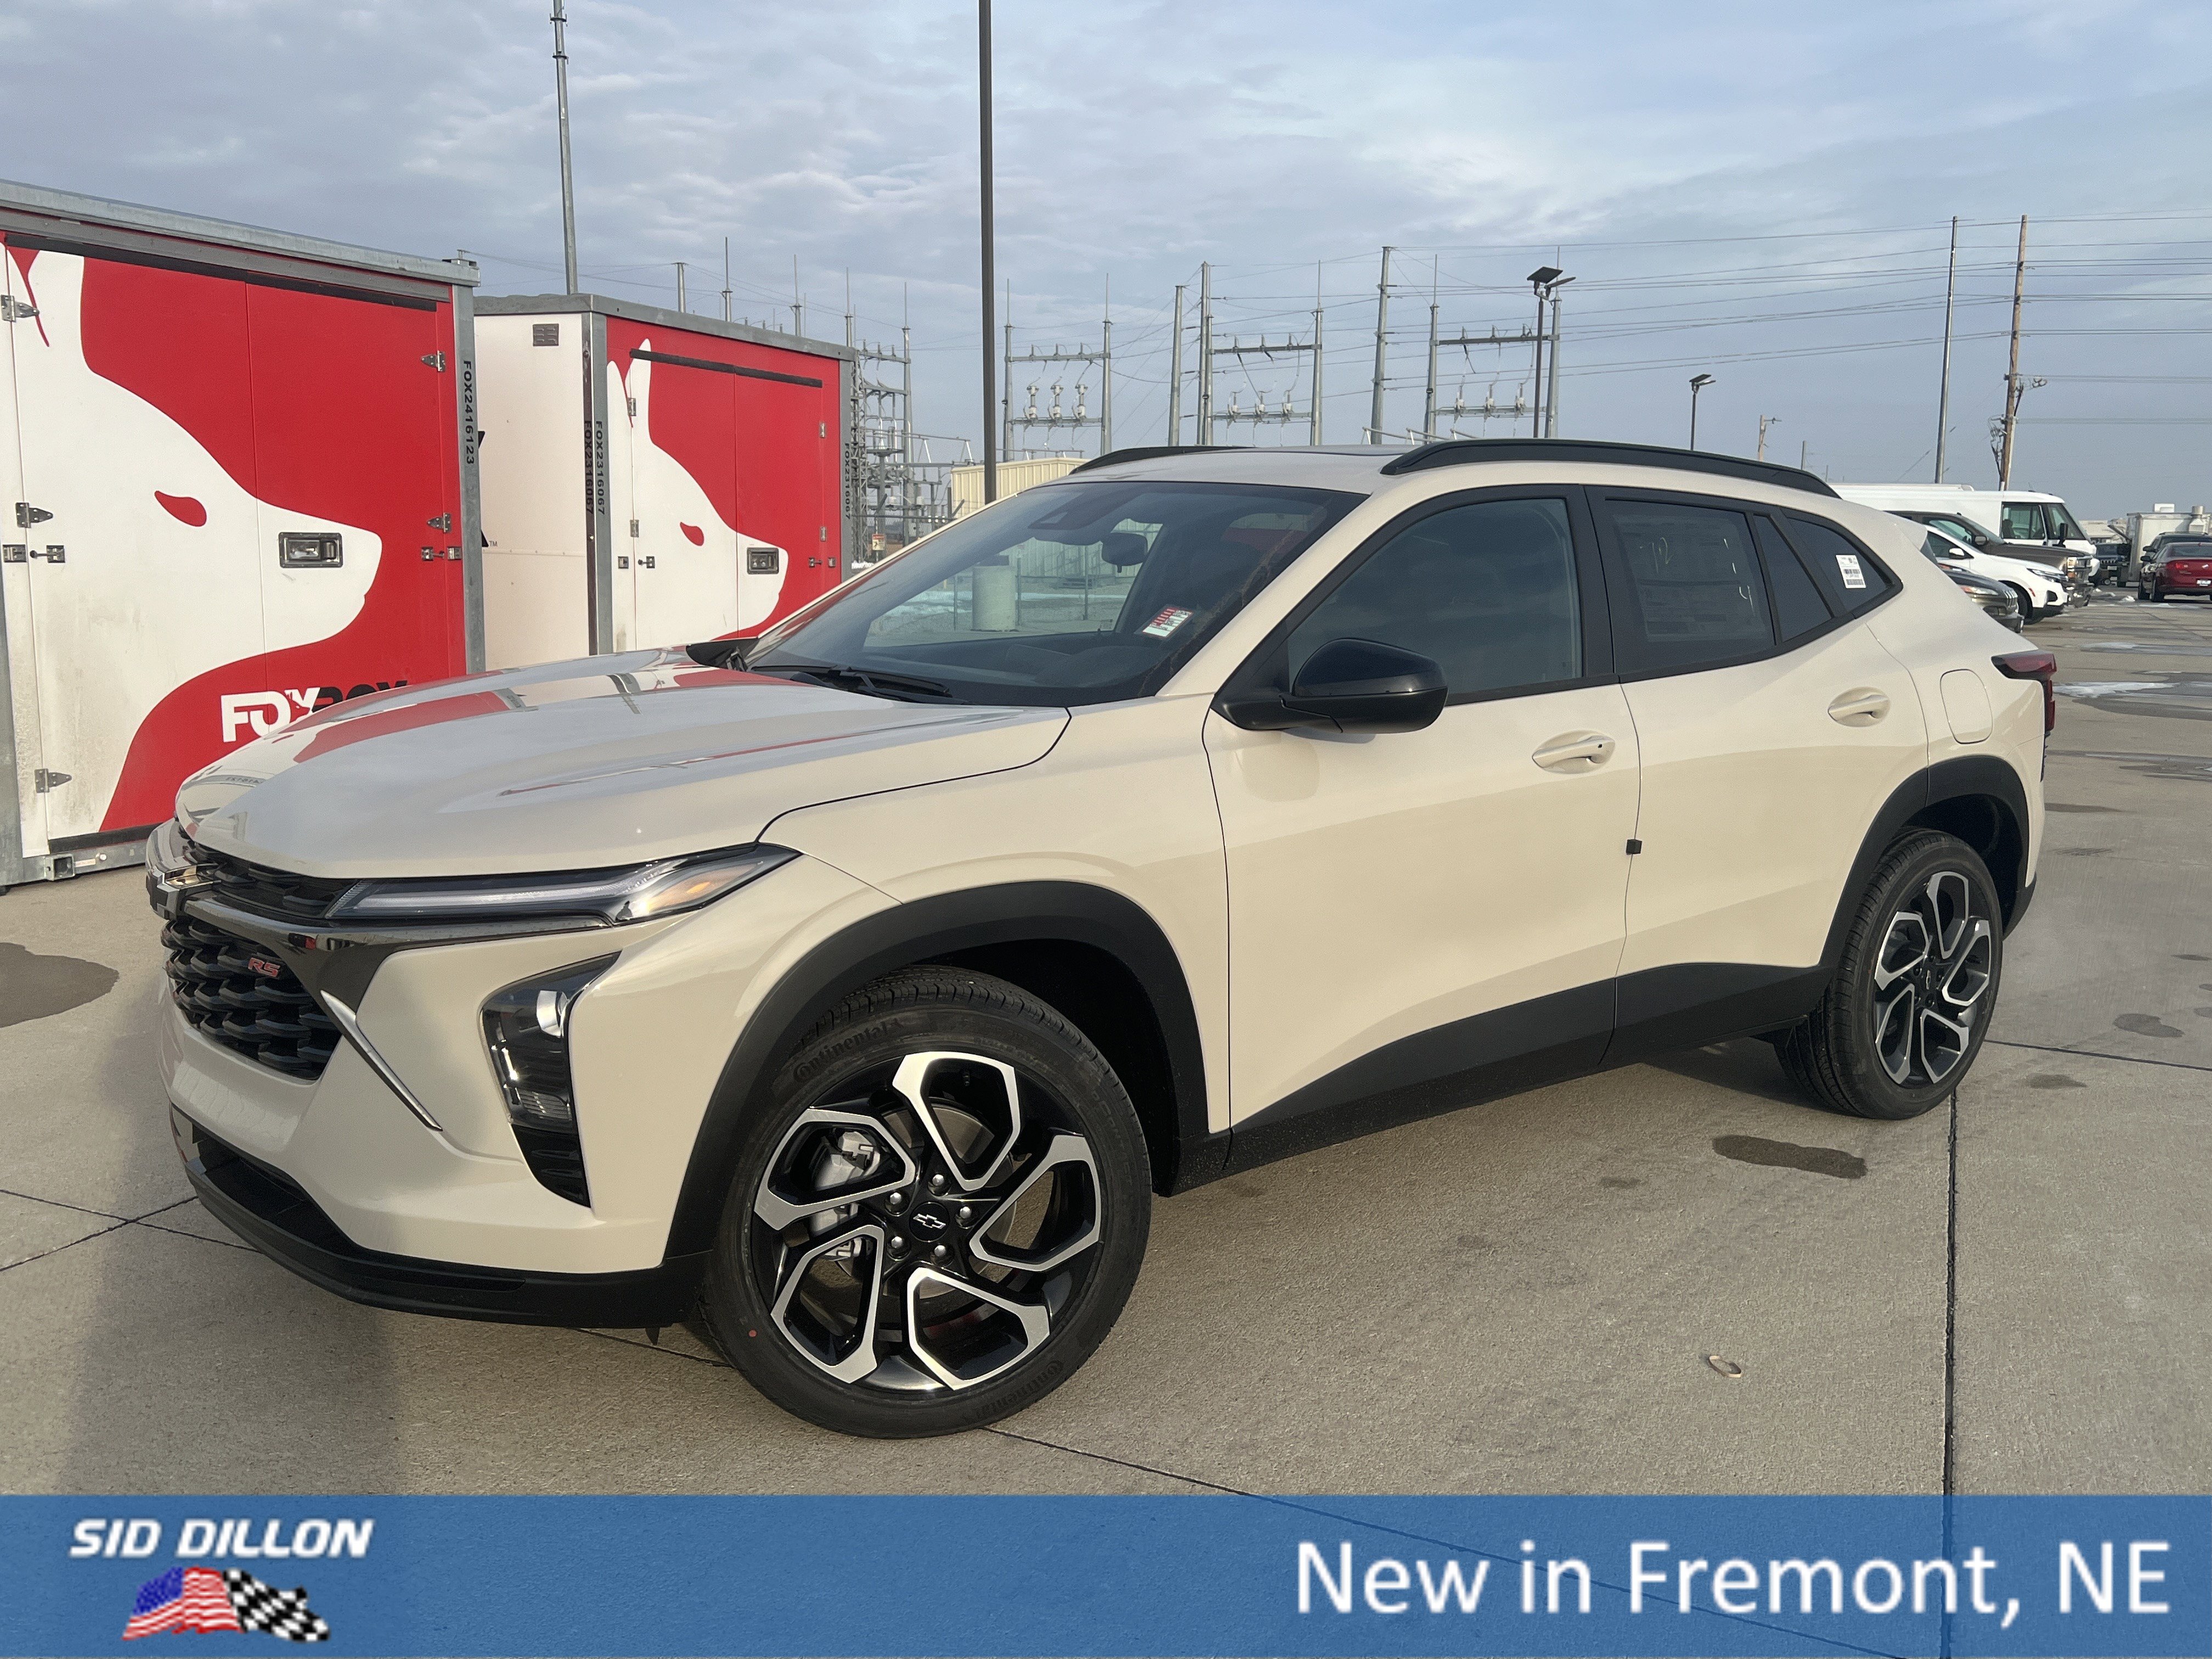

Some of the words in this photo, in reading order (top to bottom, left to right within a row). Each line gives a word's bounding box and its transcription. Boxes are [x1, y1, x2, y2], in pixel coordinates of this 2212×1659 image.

[463, 360, 474, 465] FOX2416123
[584, 420, 594, 515] FOX2316067
[596, 420, 605, 515] FOX2316067
[248, 957, 280, 977] RS
[793, 1021, 888, 1083] Continental
